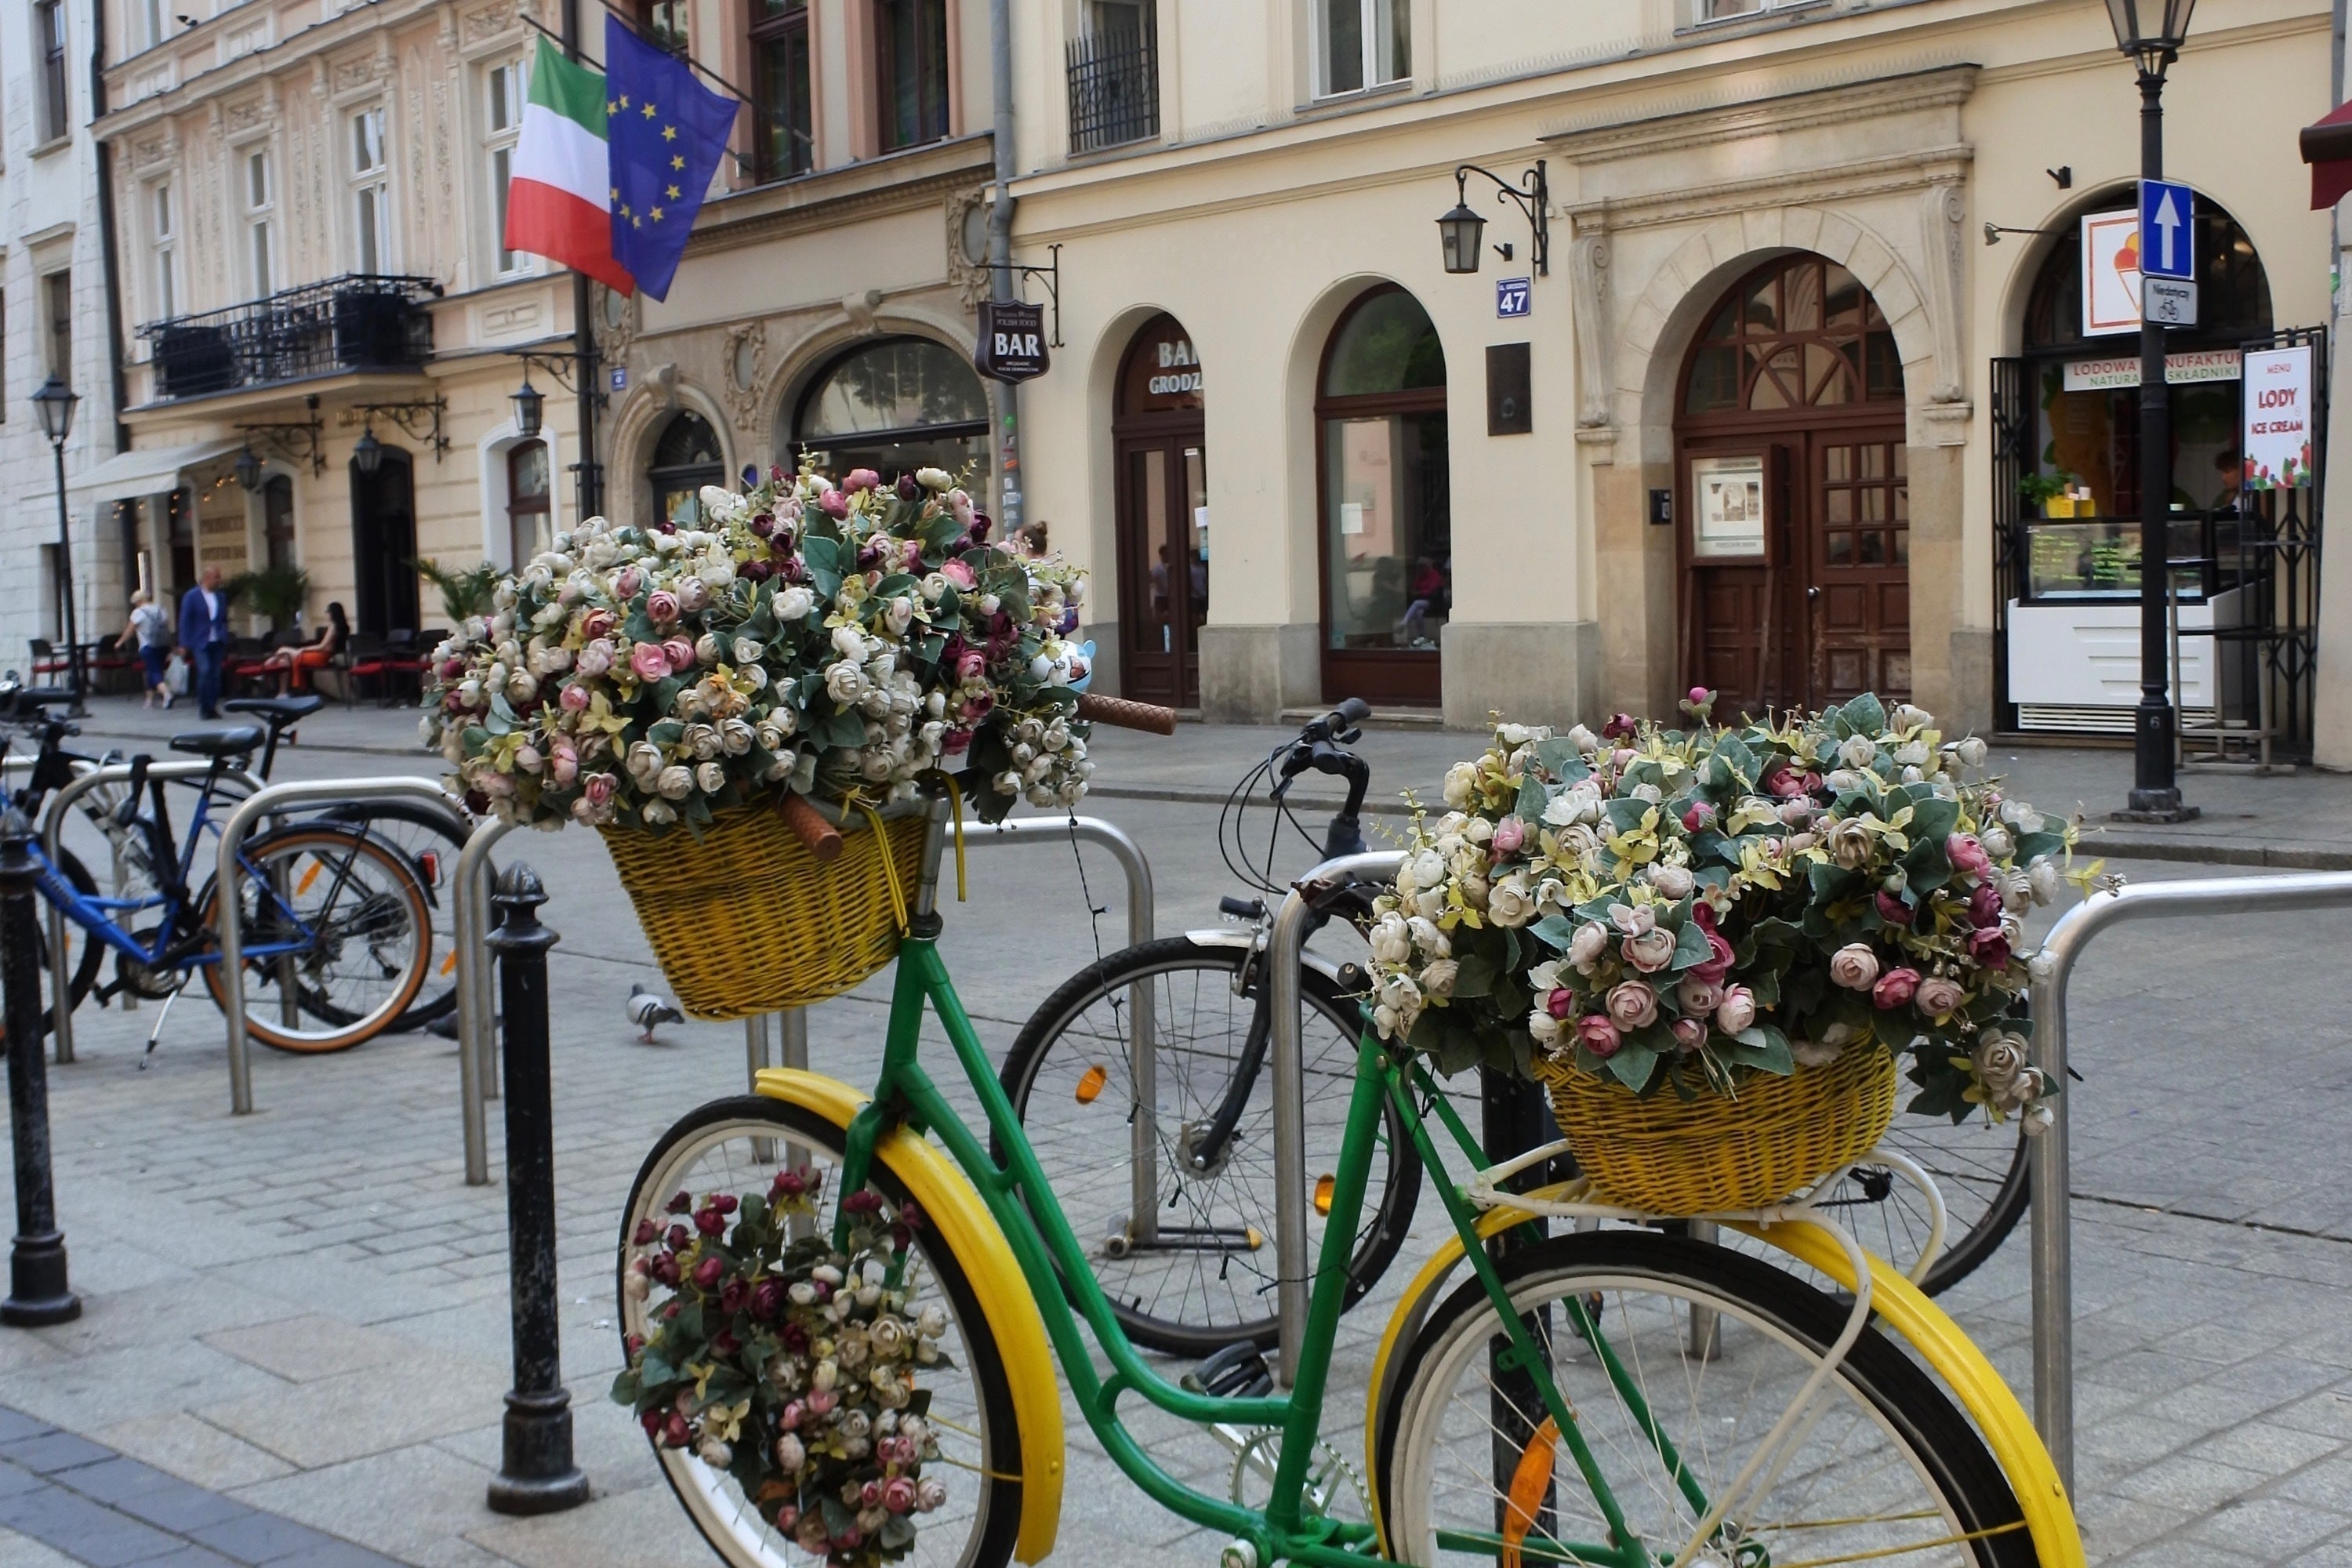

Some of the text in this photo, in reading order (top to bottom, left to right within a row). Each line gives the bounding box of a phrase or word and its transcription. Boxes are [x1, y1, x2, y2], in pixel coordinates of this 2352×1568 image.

[1500, 291, 1526, 312] 47
[994, 333, 1040, 357] BAR
[2073, 361, 2136, 376] LODOWA
[2266, 363, 2292, 375] MENU
[2089, 374, 2140, 387] NATURA
[2259, 387, 2297, 408] LODY
[2251, 420, 2303, 434] ICE CREAM
